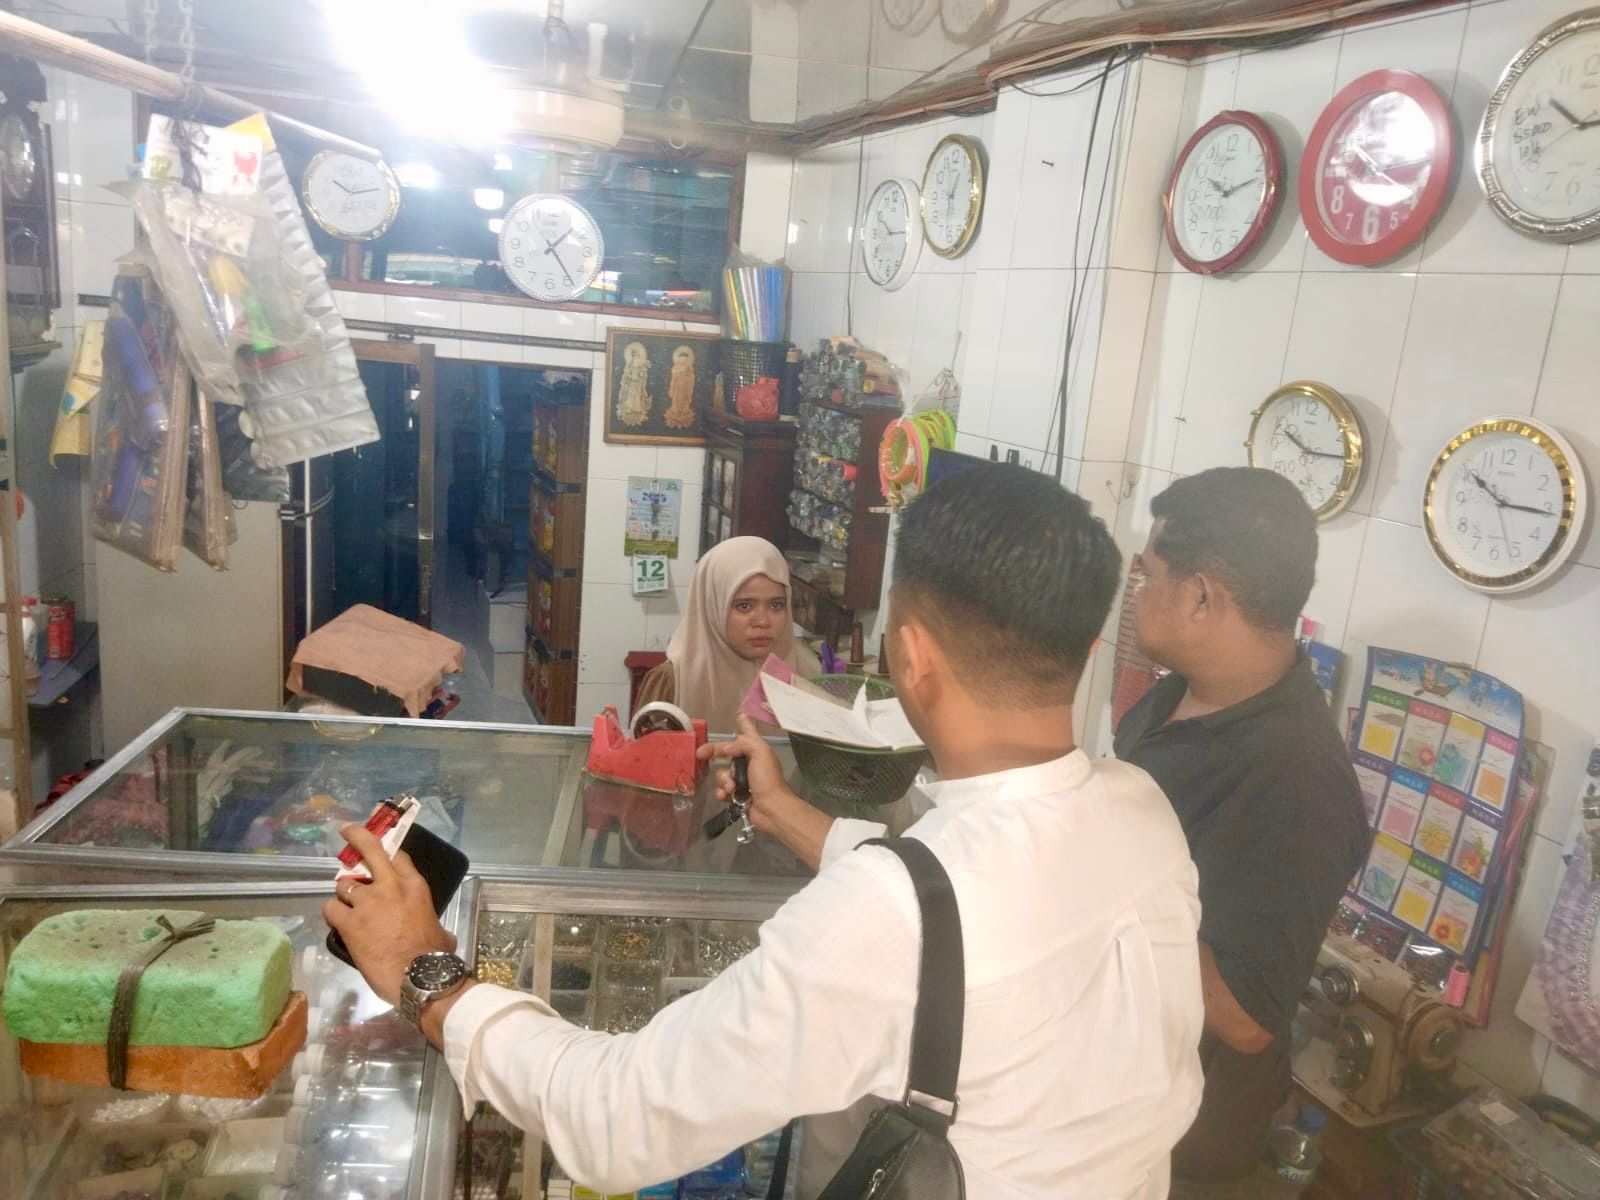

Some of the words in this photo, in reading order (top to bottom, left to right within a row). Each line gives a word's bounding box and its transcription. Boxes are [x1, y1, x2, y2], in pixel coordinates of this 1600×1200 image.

[1566, 176, 1580, 197] 6
[1331, 185, 1344, 214] 8
[1189, 214, 1199, 231] 8
[1345, 213, 1354, 230] 7
[1362, 203, 1380, 242] 6
[1390, 211, 1399, 230] 5
[511, 238, 520, 250] 9
[1200, 231, 1209, 248] 7
[1213, 236, 1223, 254] 6
[1231, 230, 1239, 247] 5
[583, 246, 592, 258] 3
[514, 256, 524, 269] 8
[528, 270, 537, 281] 7
[545, 278, 555, 290] 6
[1291, 401, 1300, 416] 11
[1306, 400, 1319, 416] 12
[1483, 452, 1494, 468] 11
[1501, 449, 1517, 465] 12
[1537, 474, 1549, 491] 2
[1456, 491, 1465, 505] 9
[1543, 502, 1552, 518] 3
[1457, 517, 1468, 533] 8
[1472, 535, 1482, 550] 7
[1528, 527, 1540, 542] 4
[1489, 545, 1500, 561] 6
[1510, 541, 1521, 558] 5
[637, 560, 665, 578] 12
